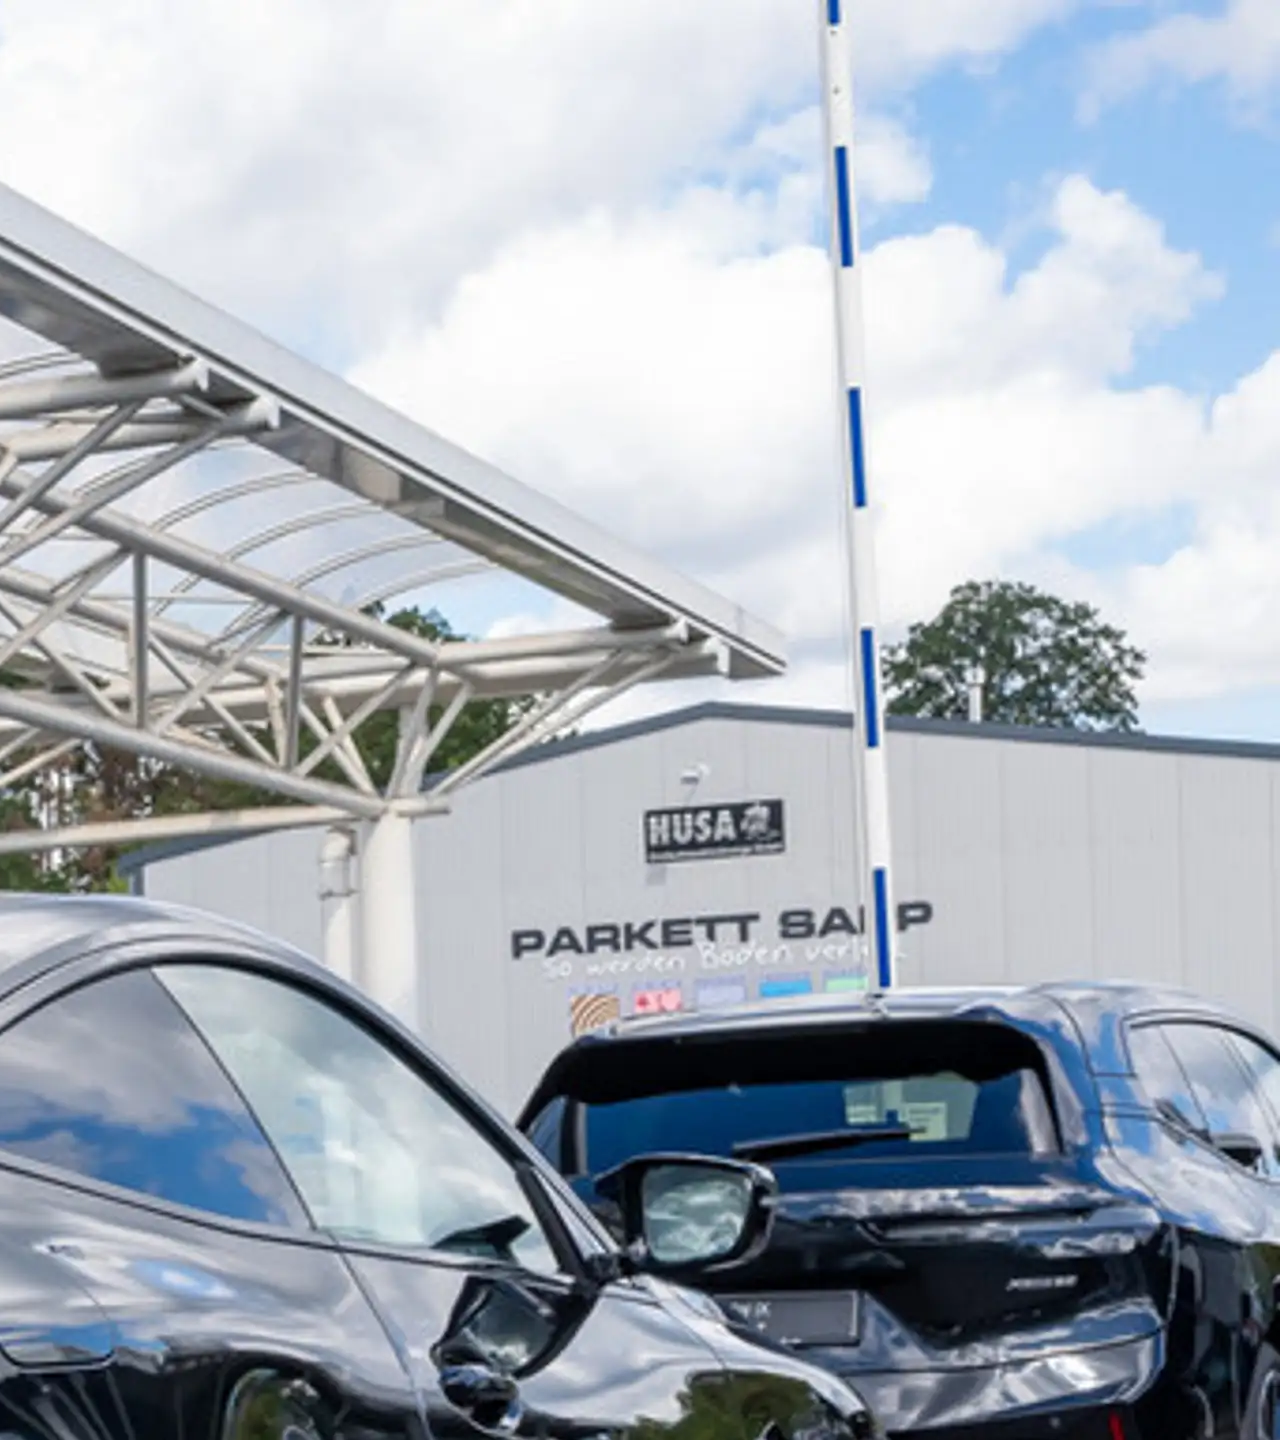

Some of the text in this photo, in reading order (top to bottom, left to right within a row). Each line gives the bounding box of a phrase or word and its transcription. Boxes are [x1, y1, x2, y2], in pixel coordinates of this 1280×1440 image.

[648, 809, 737, 846] HUSA
[512, 901, 933, 960] PARKETT SAP
[586, 948, 686, 976] werden
